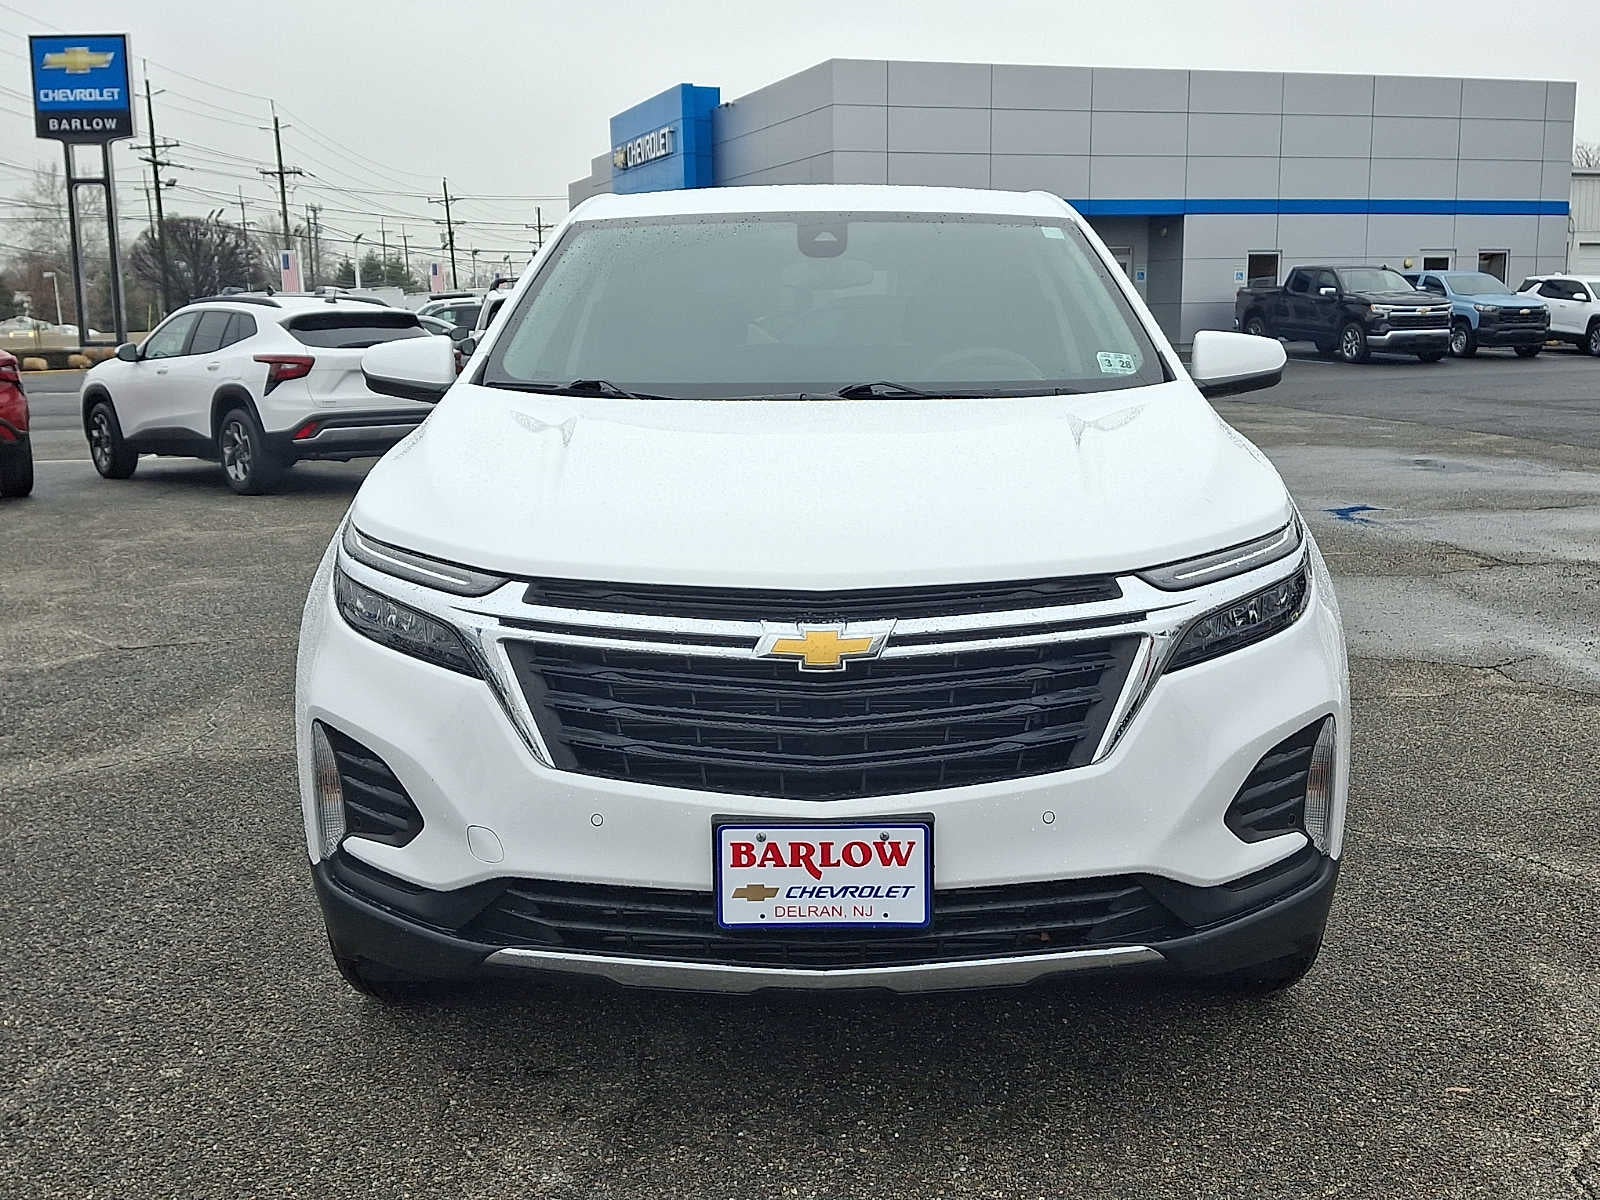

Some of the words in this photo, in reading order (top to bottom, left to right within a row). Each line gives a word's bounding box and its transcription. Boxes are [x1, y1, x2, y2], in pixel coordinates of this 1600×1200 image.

[40, 88, 120, 102] CHEVROLET
[48, 118, 117, 131] BARLOW
[626, 126, 675, 168] CHEVROLET
[1104, 359, 1112, 368] 3
[1119, 360, 1132, 369] 28
[730, 841, 916, 881] BARLOW
[785, 885, 916, 899] CHEVROLET
[774, 905, 847, 919] DELRAN,
[852, 905, 874, 918] NJ
